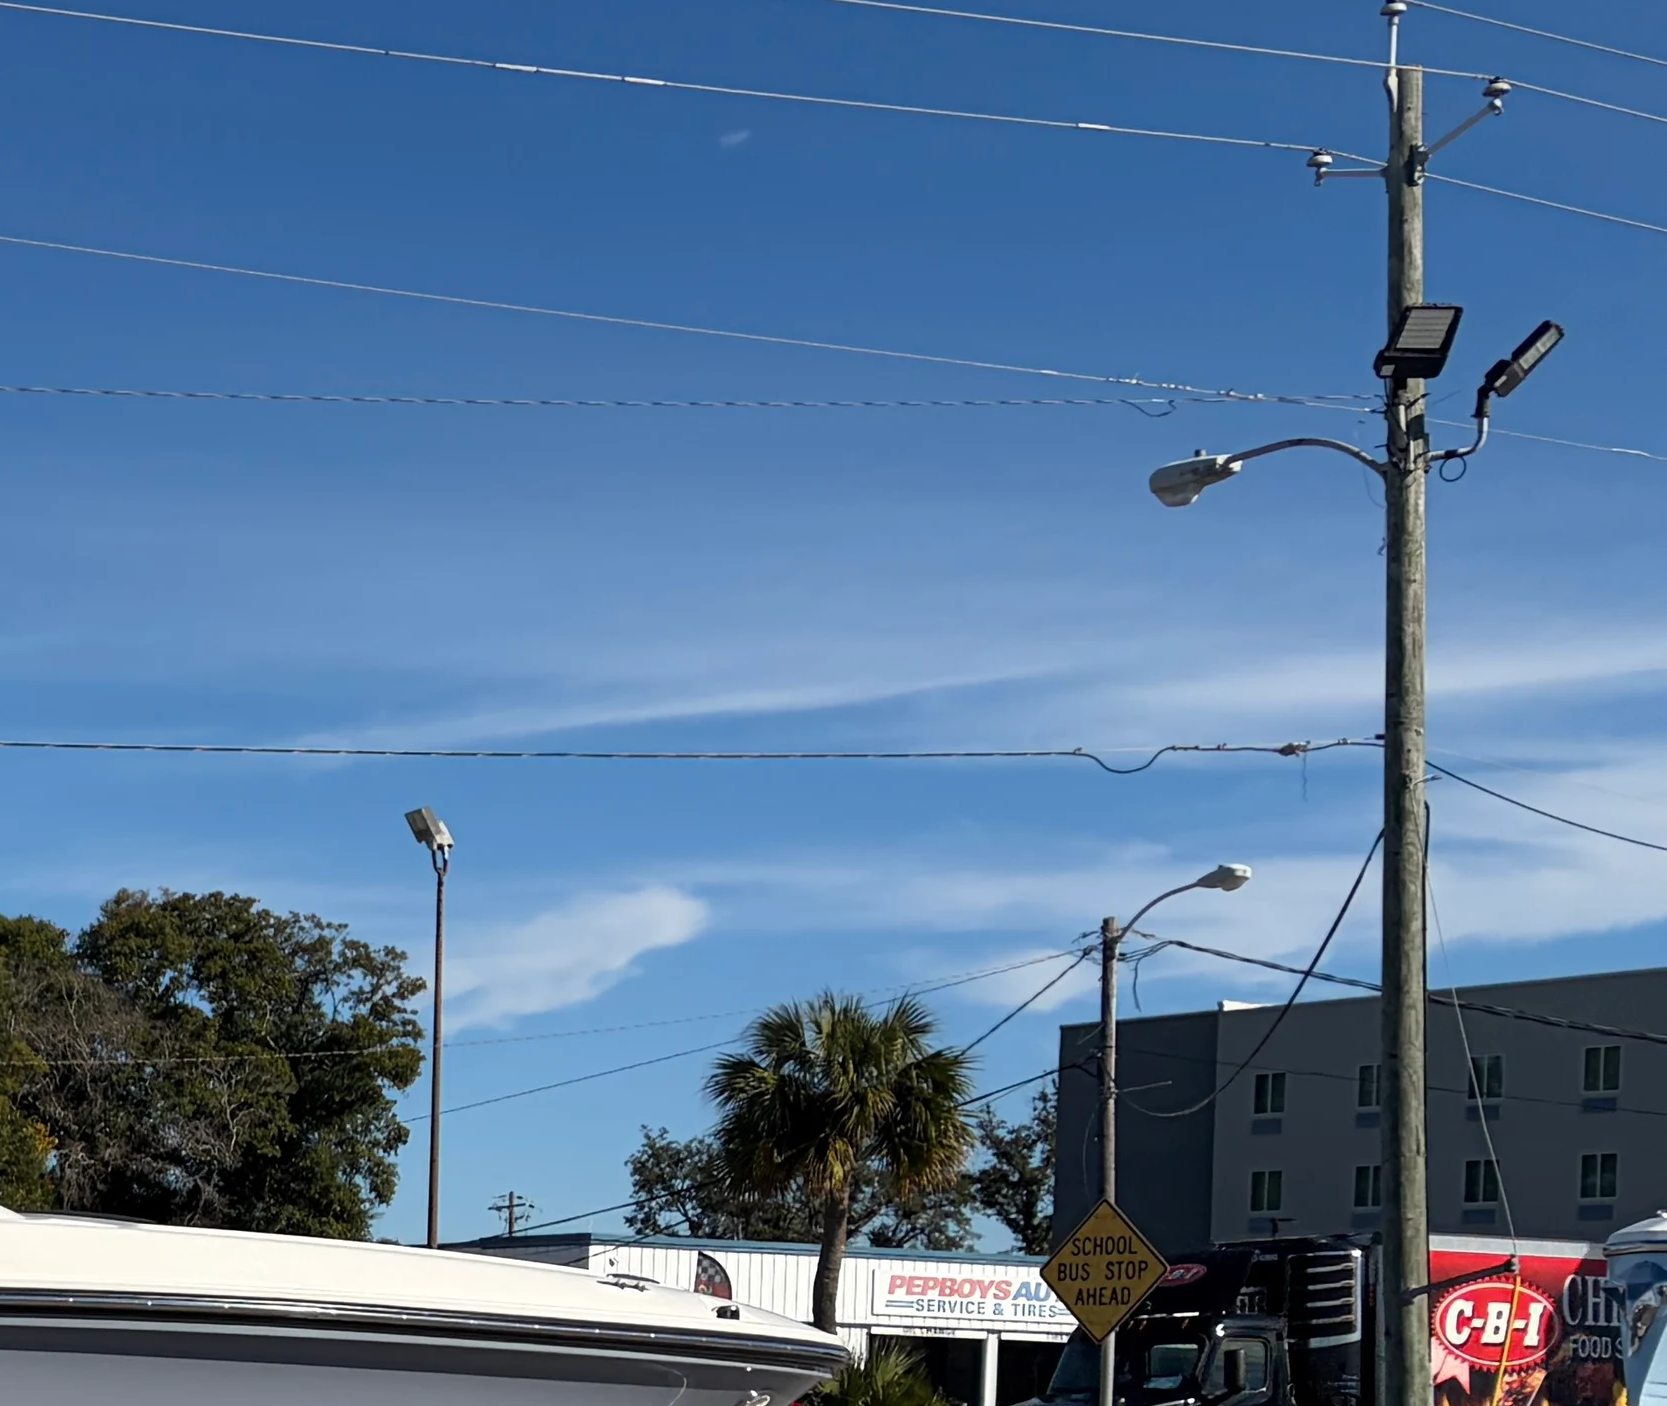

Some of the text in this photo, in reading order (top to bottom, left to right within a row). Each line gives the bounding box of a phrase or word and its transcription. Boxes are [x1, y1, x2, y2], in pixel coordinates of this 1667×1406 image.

[1071, 1236, 1137, 1256] SCHOOL
[1057, 1260, 1149, 1281] BUS STOP
[887, 1274, 1061, 1303] PEPBOYS AU
[1074, 1286, 1132, 1306] AHEAD
[915, 1298, 1057, 1318] SERVICE & TIRES
[1445, 1298, 1545, 1347] C-B-I
[1569, 1335, 1612, 1358] FOOD
